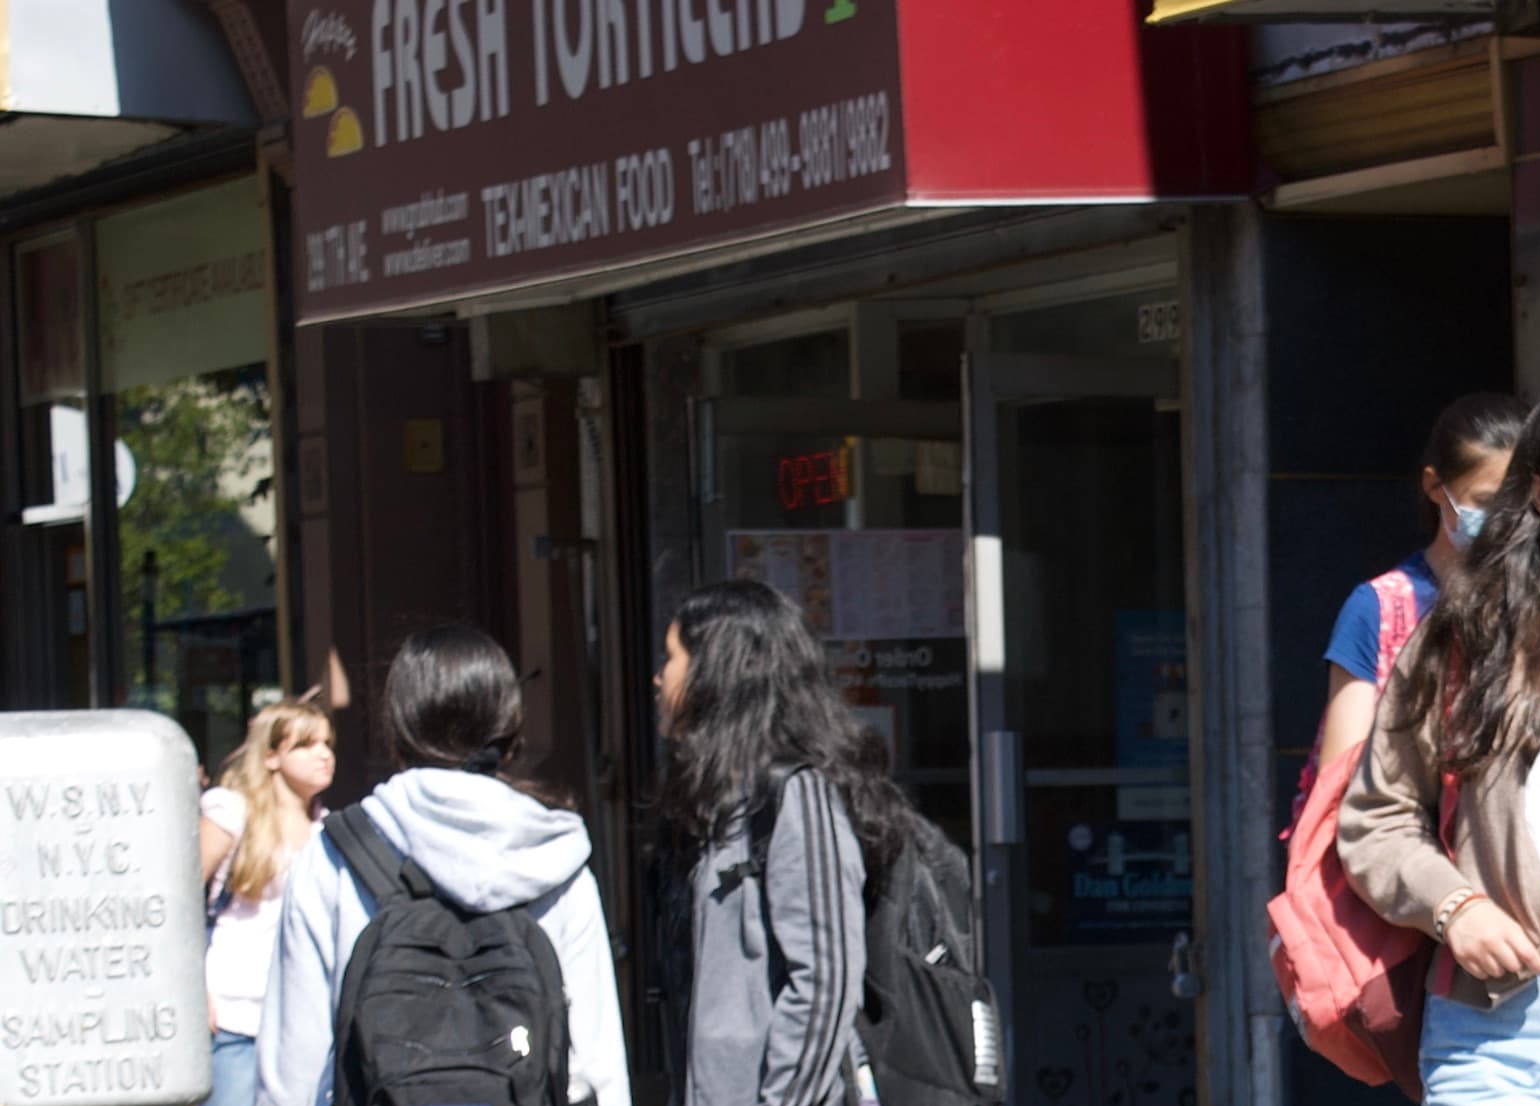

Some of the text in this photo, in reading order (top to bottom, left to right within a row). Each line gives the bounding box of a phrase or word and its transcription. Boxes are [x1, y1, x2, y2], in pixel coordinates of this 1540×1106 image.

[371, 0, 807, 148] FRESH TORTI
[481, 160, 612, 259] TEX-MEXICAN
[614, 147, 676, 234] FOOD
[777, 450, 849, 511] OPEN
[1, 894, 166, 936] DRINKING
[20, 944, 153, 984] WATER
[2, 1006, 177, 1050] SAMPLING
[19, 1053, 164, 1099] STATION
